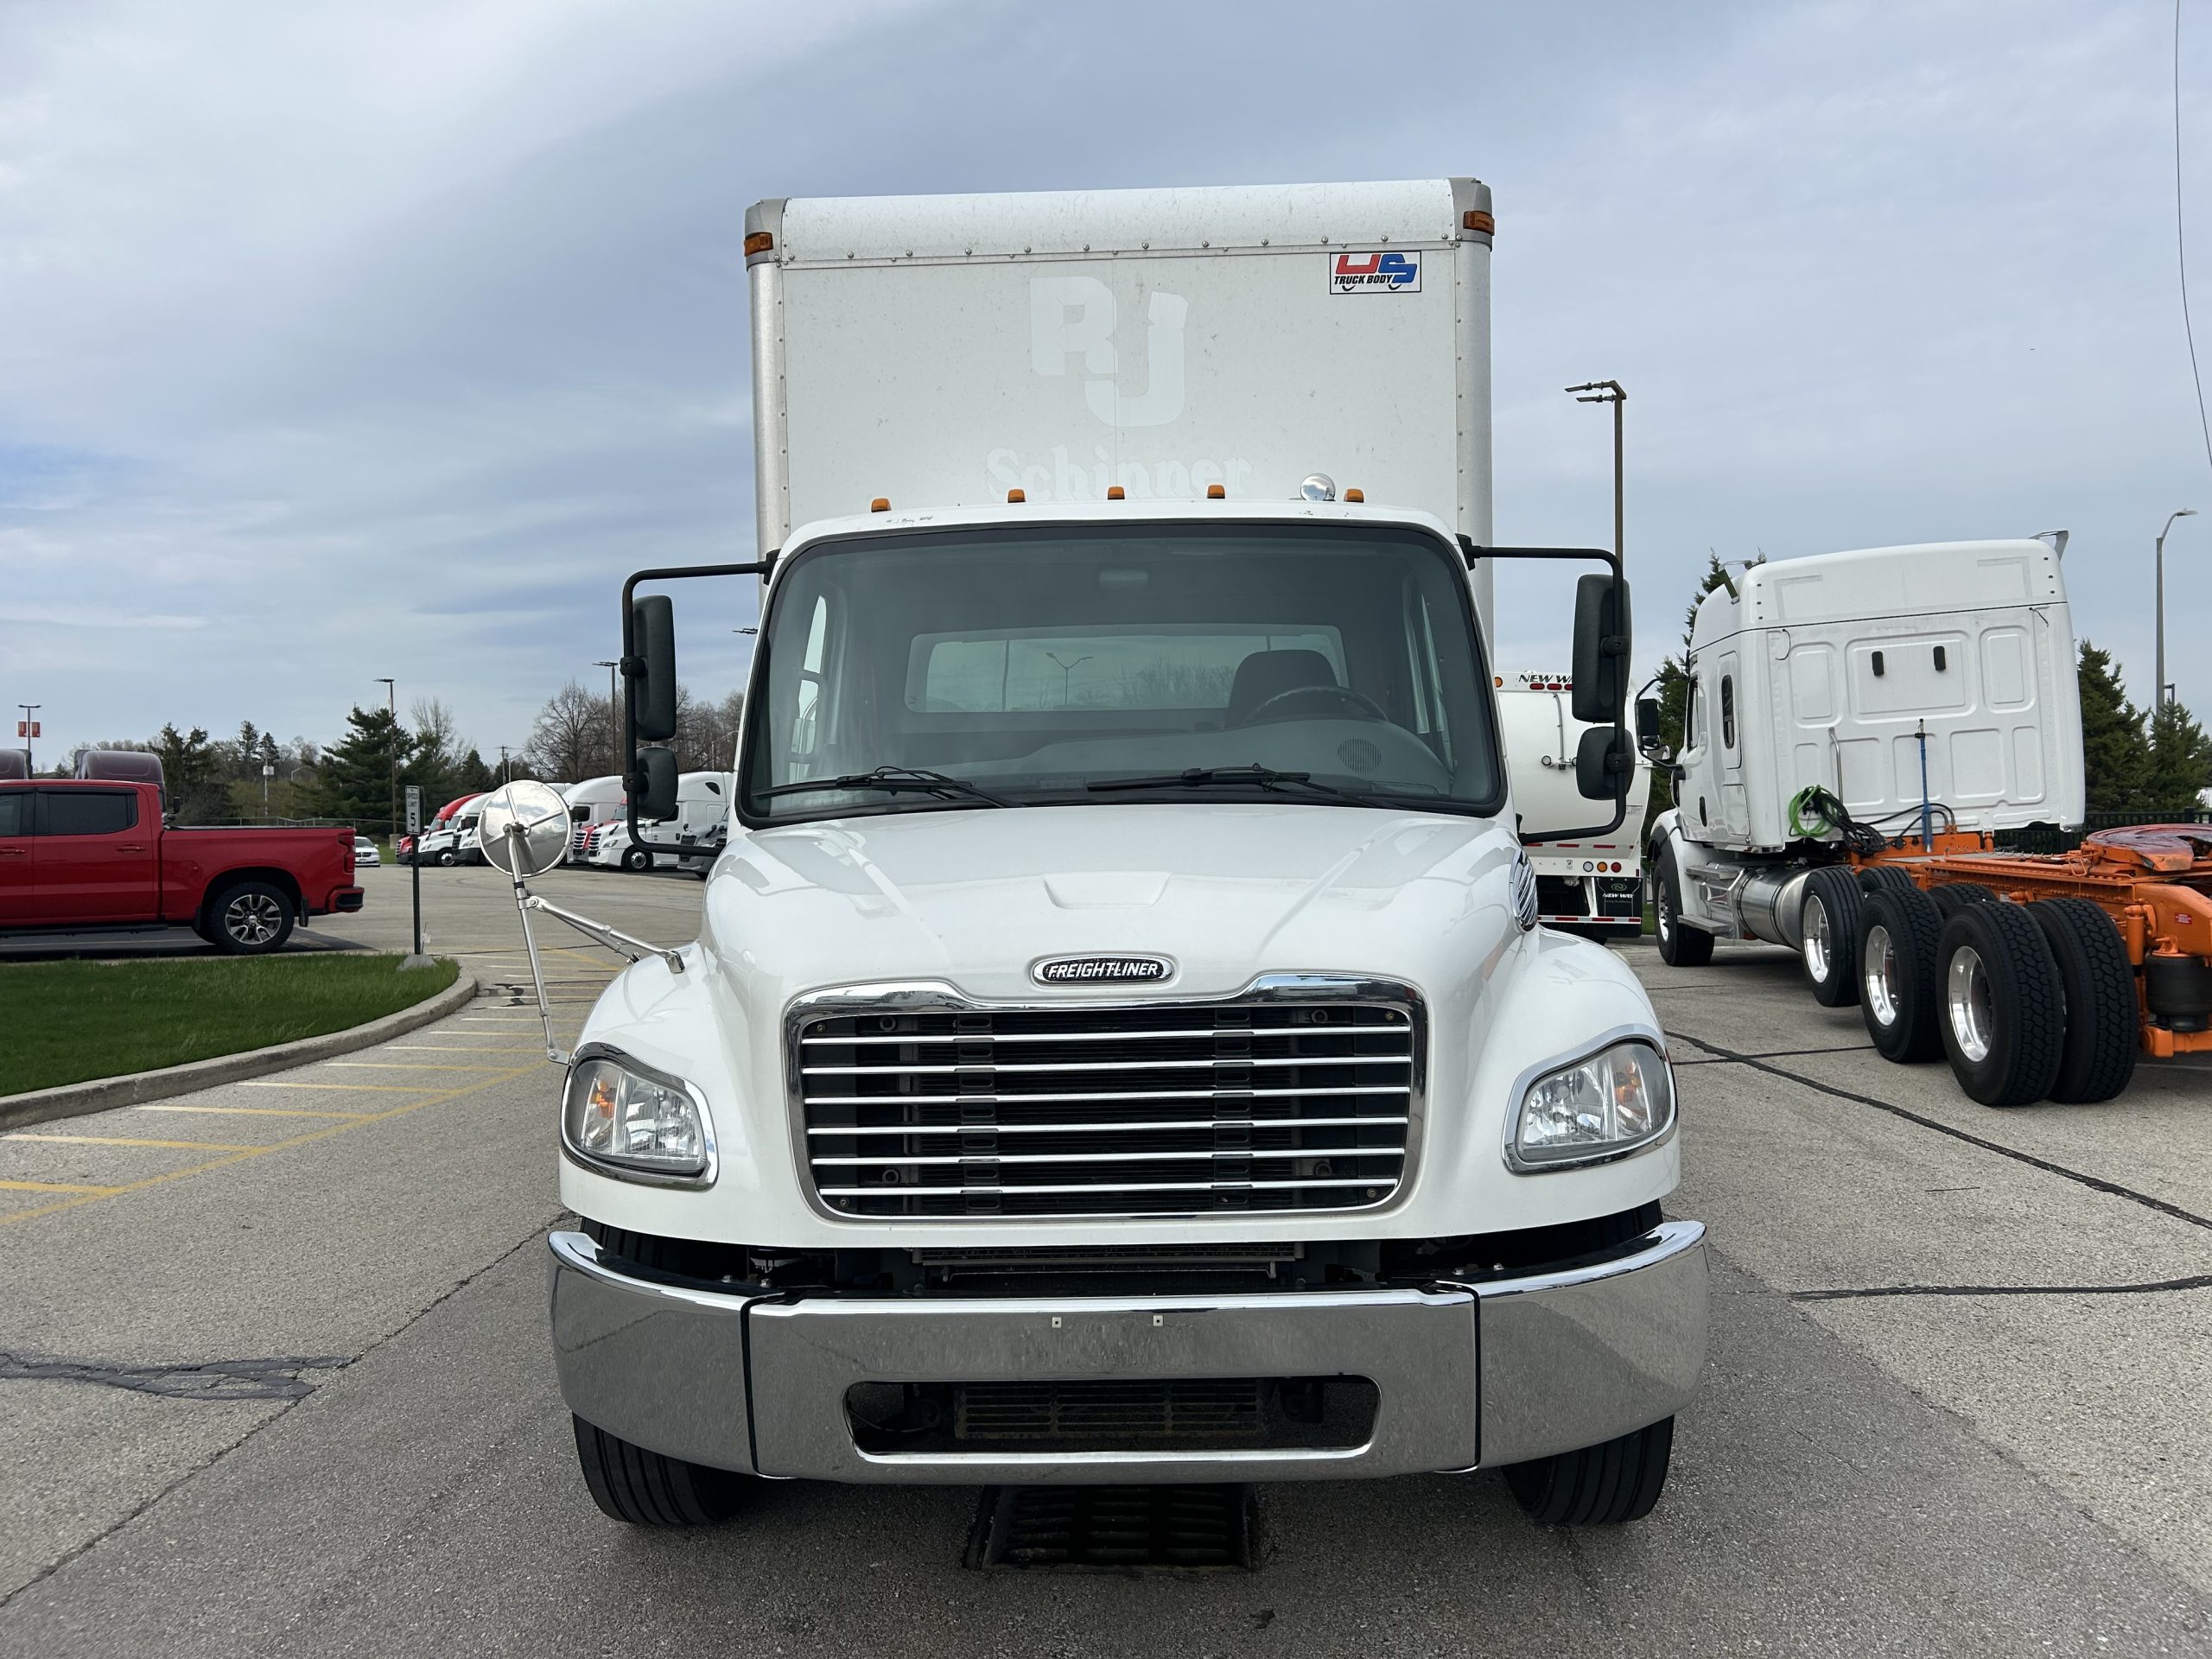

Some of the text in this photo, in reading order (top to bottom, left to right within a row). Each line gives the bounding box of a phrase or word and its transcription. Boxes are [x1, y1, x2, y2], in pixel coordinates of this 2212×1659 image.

[1336, 254, 1417, 283] US
[1334, 274, 1393, 285] TRUCK BODY
[1029, 276, 1189, 428] RJ
[987, 444, 1252, 504] Schinner
[1518, 674, 1554, 683] NEW
[410, 812, 416, 827] 5
[1048, 961, 1158, 978] FREIGHTLINER
